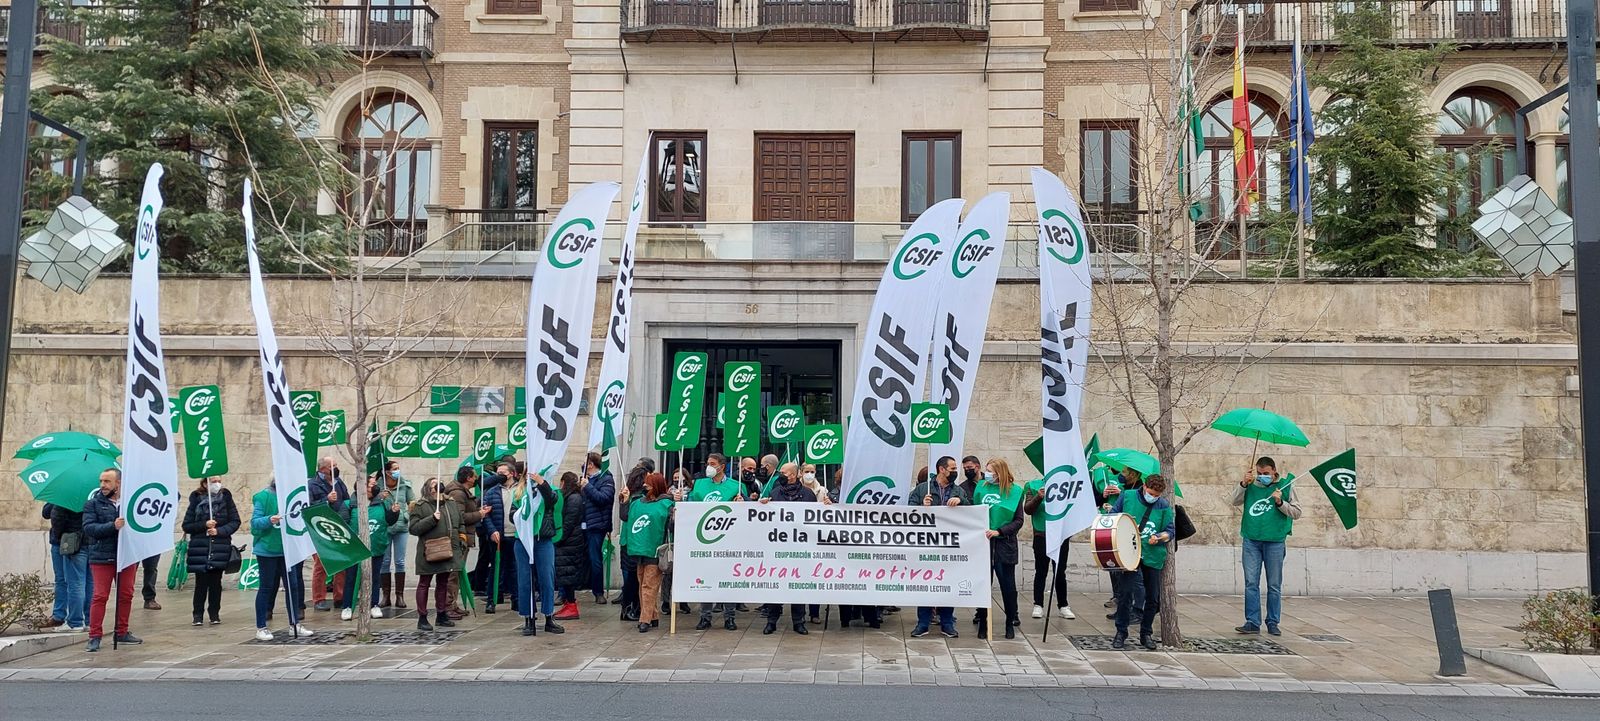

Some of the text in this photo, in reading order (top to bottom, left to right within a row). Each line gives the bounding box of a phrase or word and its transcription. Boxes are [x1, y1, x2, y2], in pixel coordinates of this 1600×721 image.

[745, 304, 758, 314] 56
[129, 298, 168, 452] CSIF
[534, 304, 579, 441] CSIF
[862, 312, 919, 448] CSIF
[676, 384, 694, 441] CSIF
[736, 394, 749, 453] CSIF
[197, 416, 213, 475] CSIF
[747, 508, 936, 526] Por la DIGNIFICACIÓN
[768, 528, 960, 547] de la LABOR DOCENTE
[713, 550, 742, 558] ENSEÑANZA
[743, 550, 764, 558] PÚBLICA
[774, 551, 811, 559] EQUIPARACIÓN
[872, 553, 907, 561] PROFESIONAL
[919, 554, 940, 562] BAJADA
[732, 560, 945, 581] Sobran los motivos
[718, 580, 750, 589] AMPLIACIÓN
[788, 581, 817, 590] REDUCCIÓN
[818, 582, 825, 590] DE
[834, 583, 867, 591] BUROCRACIA
[875, 583, 904, 592] REDUCCIÓN
[930, 585, 951, 593] LECTIVO
